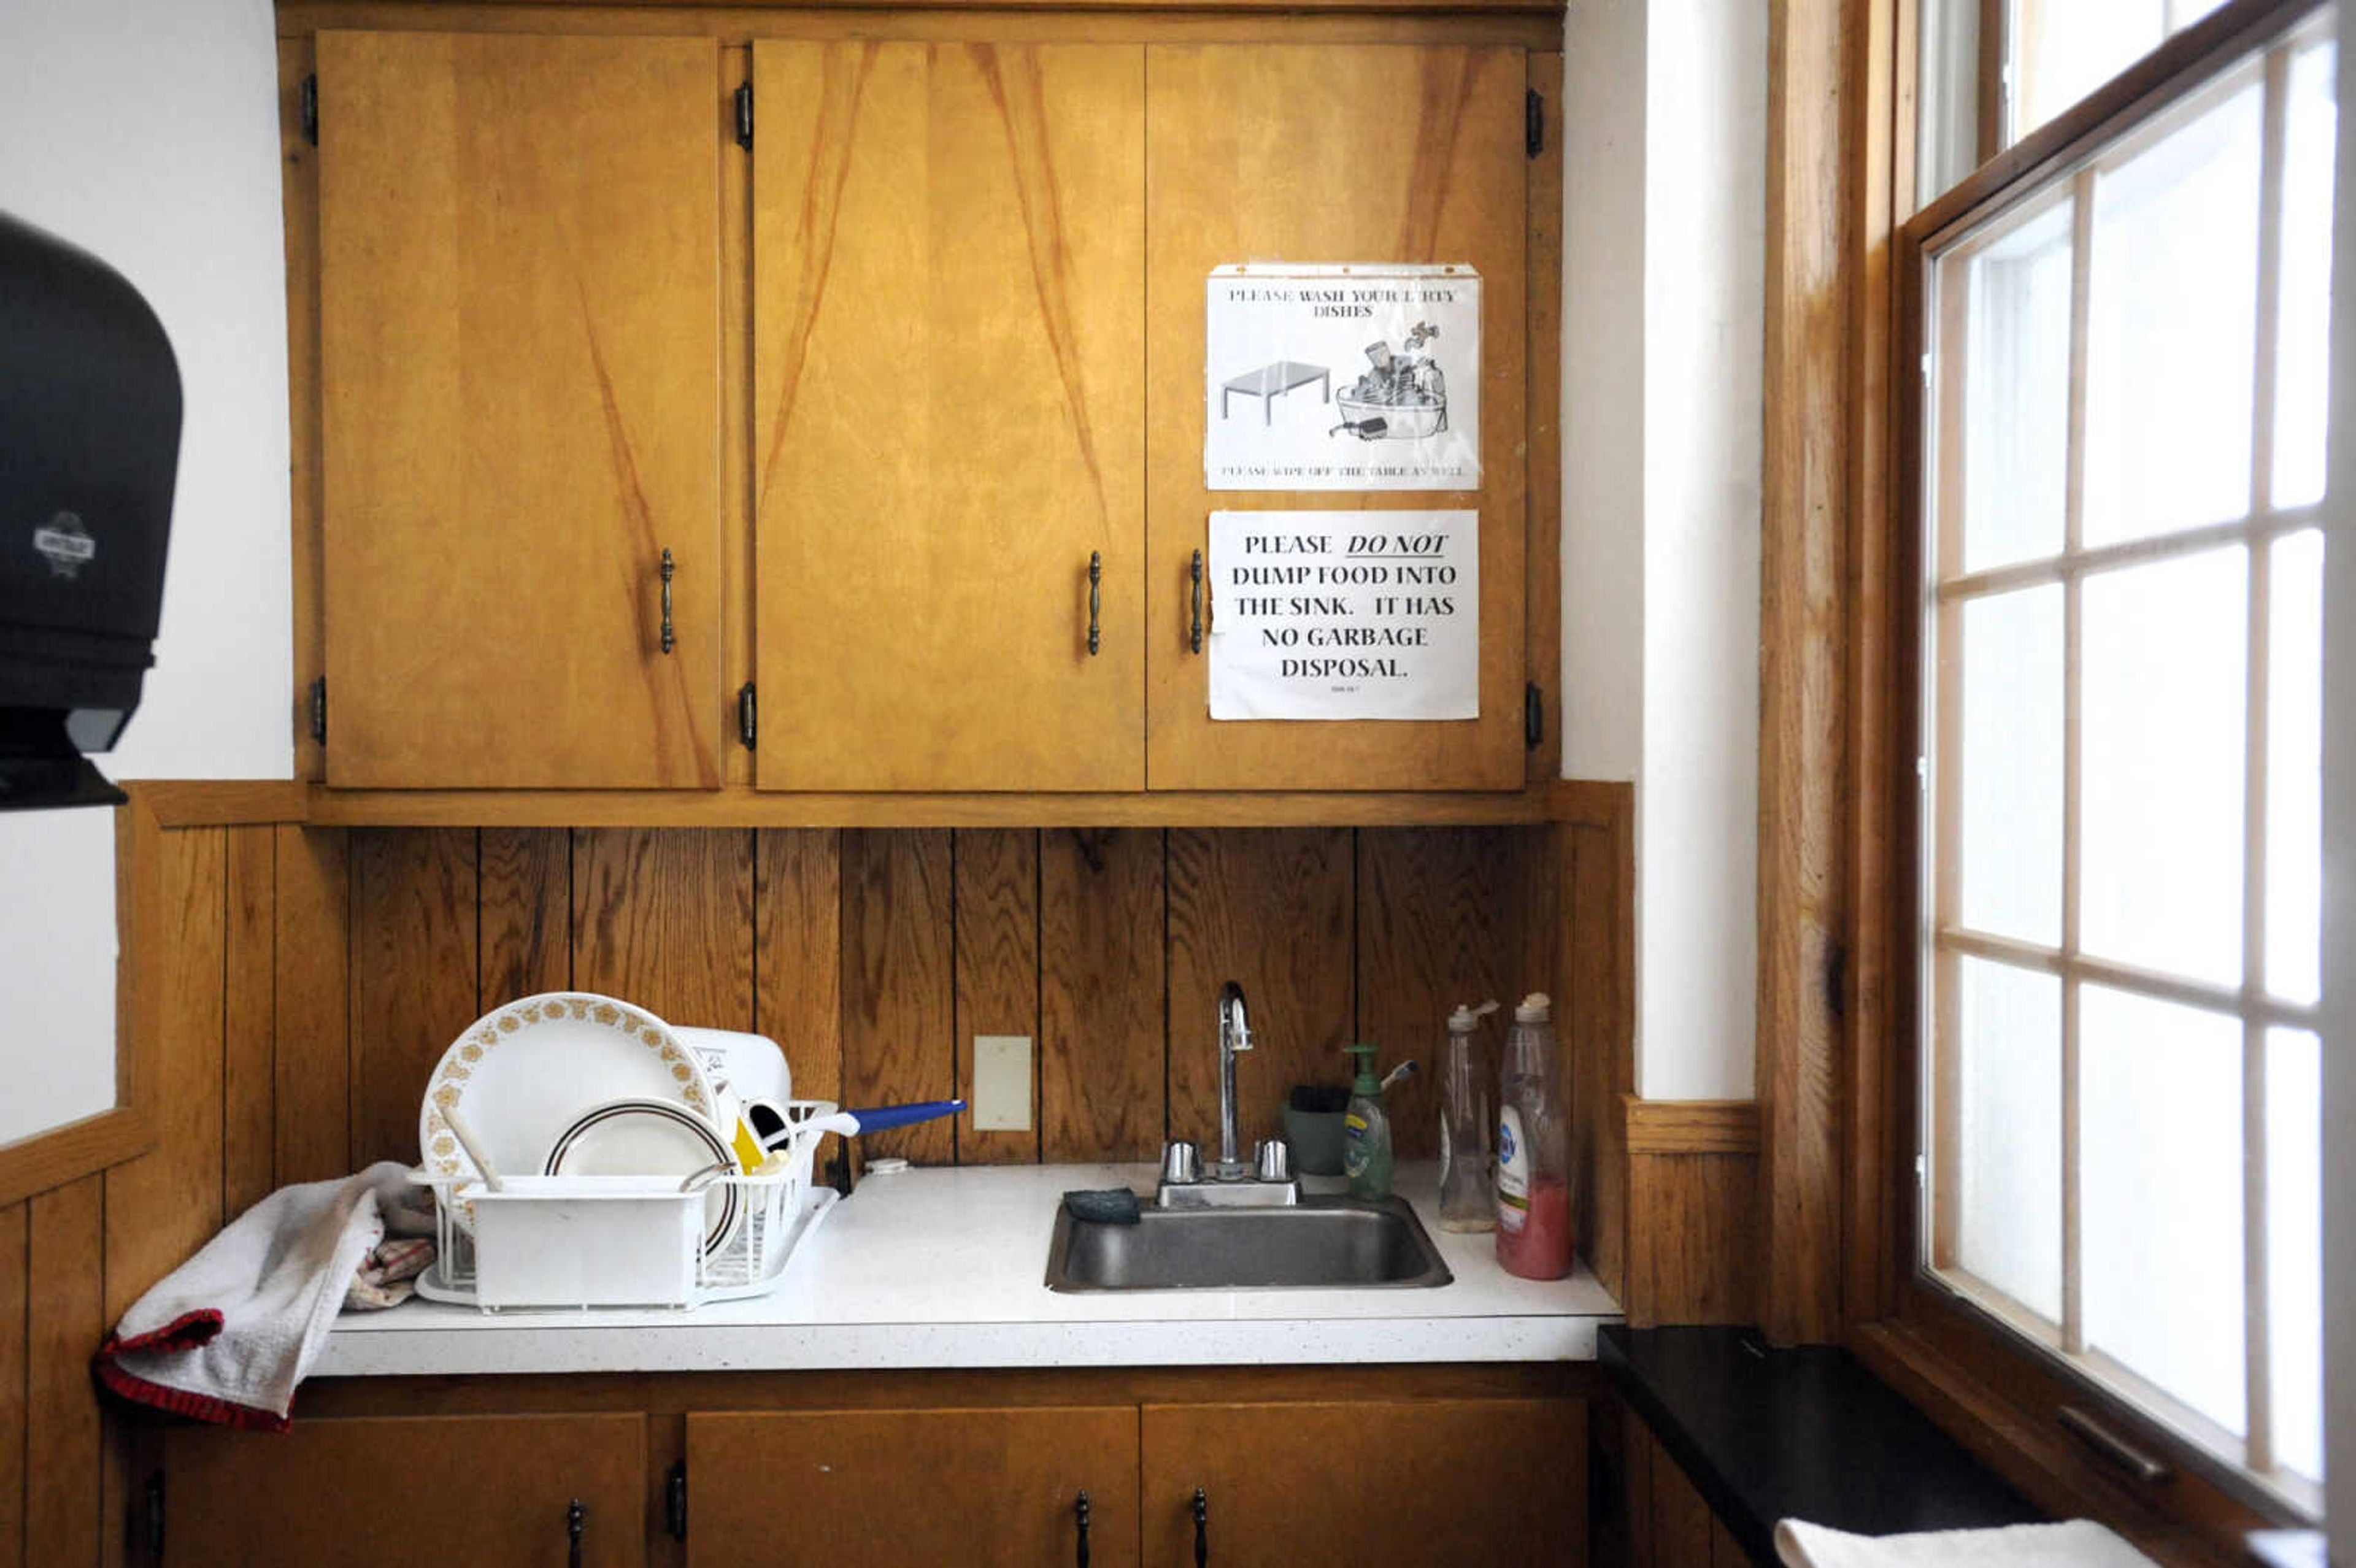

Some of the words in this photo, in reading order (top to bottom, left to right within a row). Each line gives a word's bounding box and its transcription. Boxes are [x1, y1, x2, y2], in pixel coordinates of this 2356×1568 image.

[1229, 290, 1292, 302] PLEASE
[1299, 290, 1344, 302] WASH
[1351, 290, 1398, 302] YOUR
[1314, 304, 1374, 318] DISHES
[1245, 535, 1332, 554] PLEASE
[1348, 535, 1387, 554] DO
[1393, 535, 1449, 554] NOT
[1233, 566, 1311, 585] DUMP
[1319, 566, 1388, 585] FOOD
[1396, 566, 1457, 585] INTO
[1235, 597, 1284, 615] THE
[1290, 597, 1354, 615] SINK.
[1375, 597, 1399, 615] IT
[1406, 597, 1455, 615] HAS
[1262, 628, 1299, 647] NO
[1307, 628, 1428, 647] GARBAGE
[1282, 658, 1409, 677] DISPOSAL.
